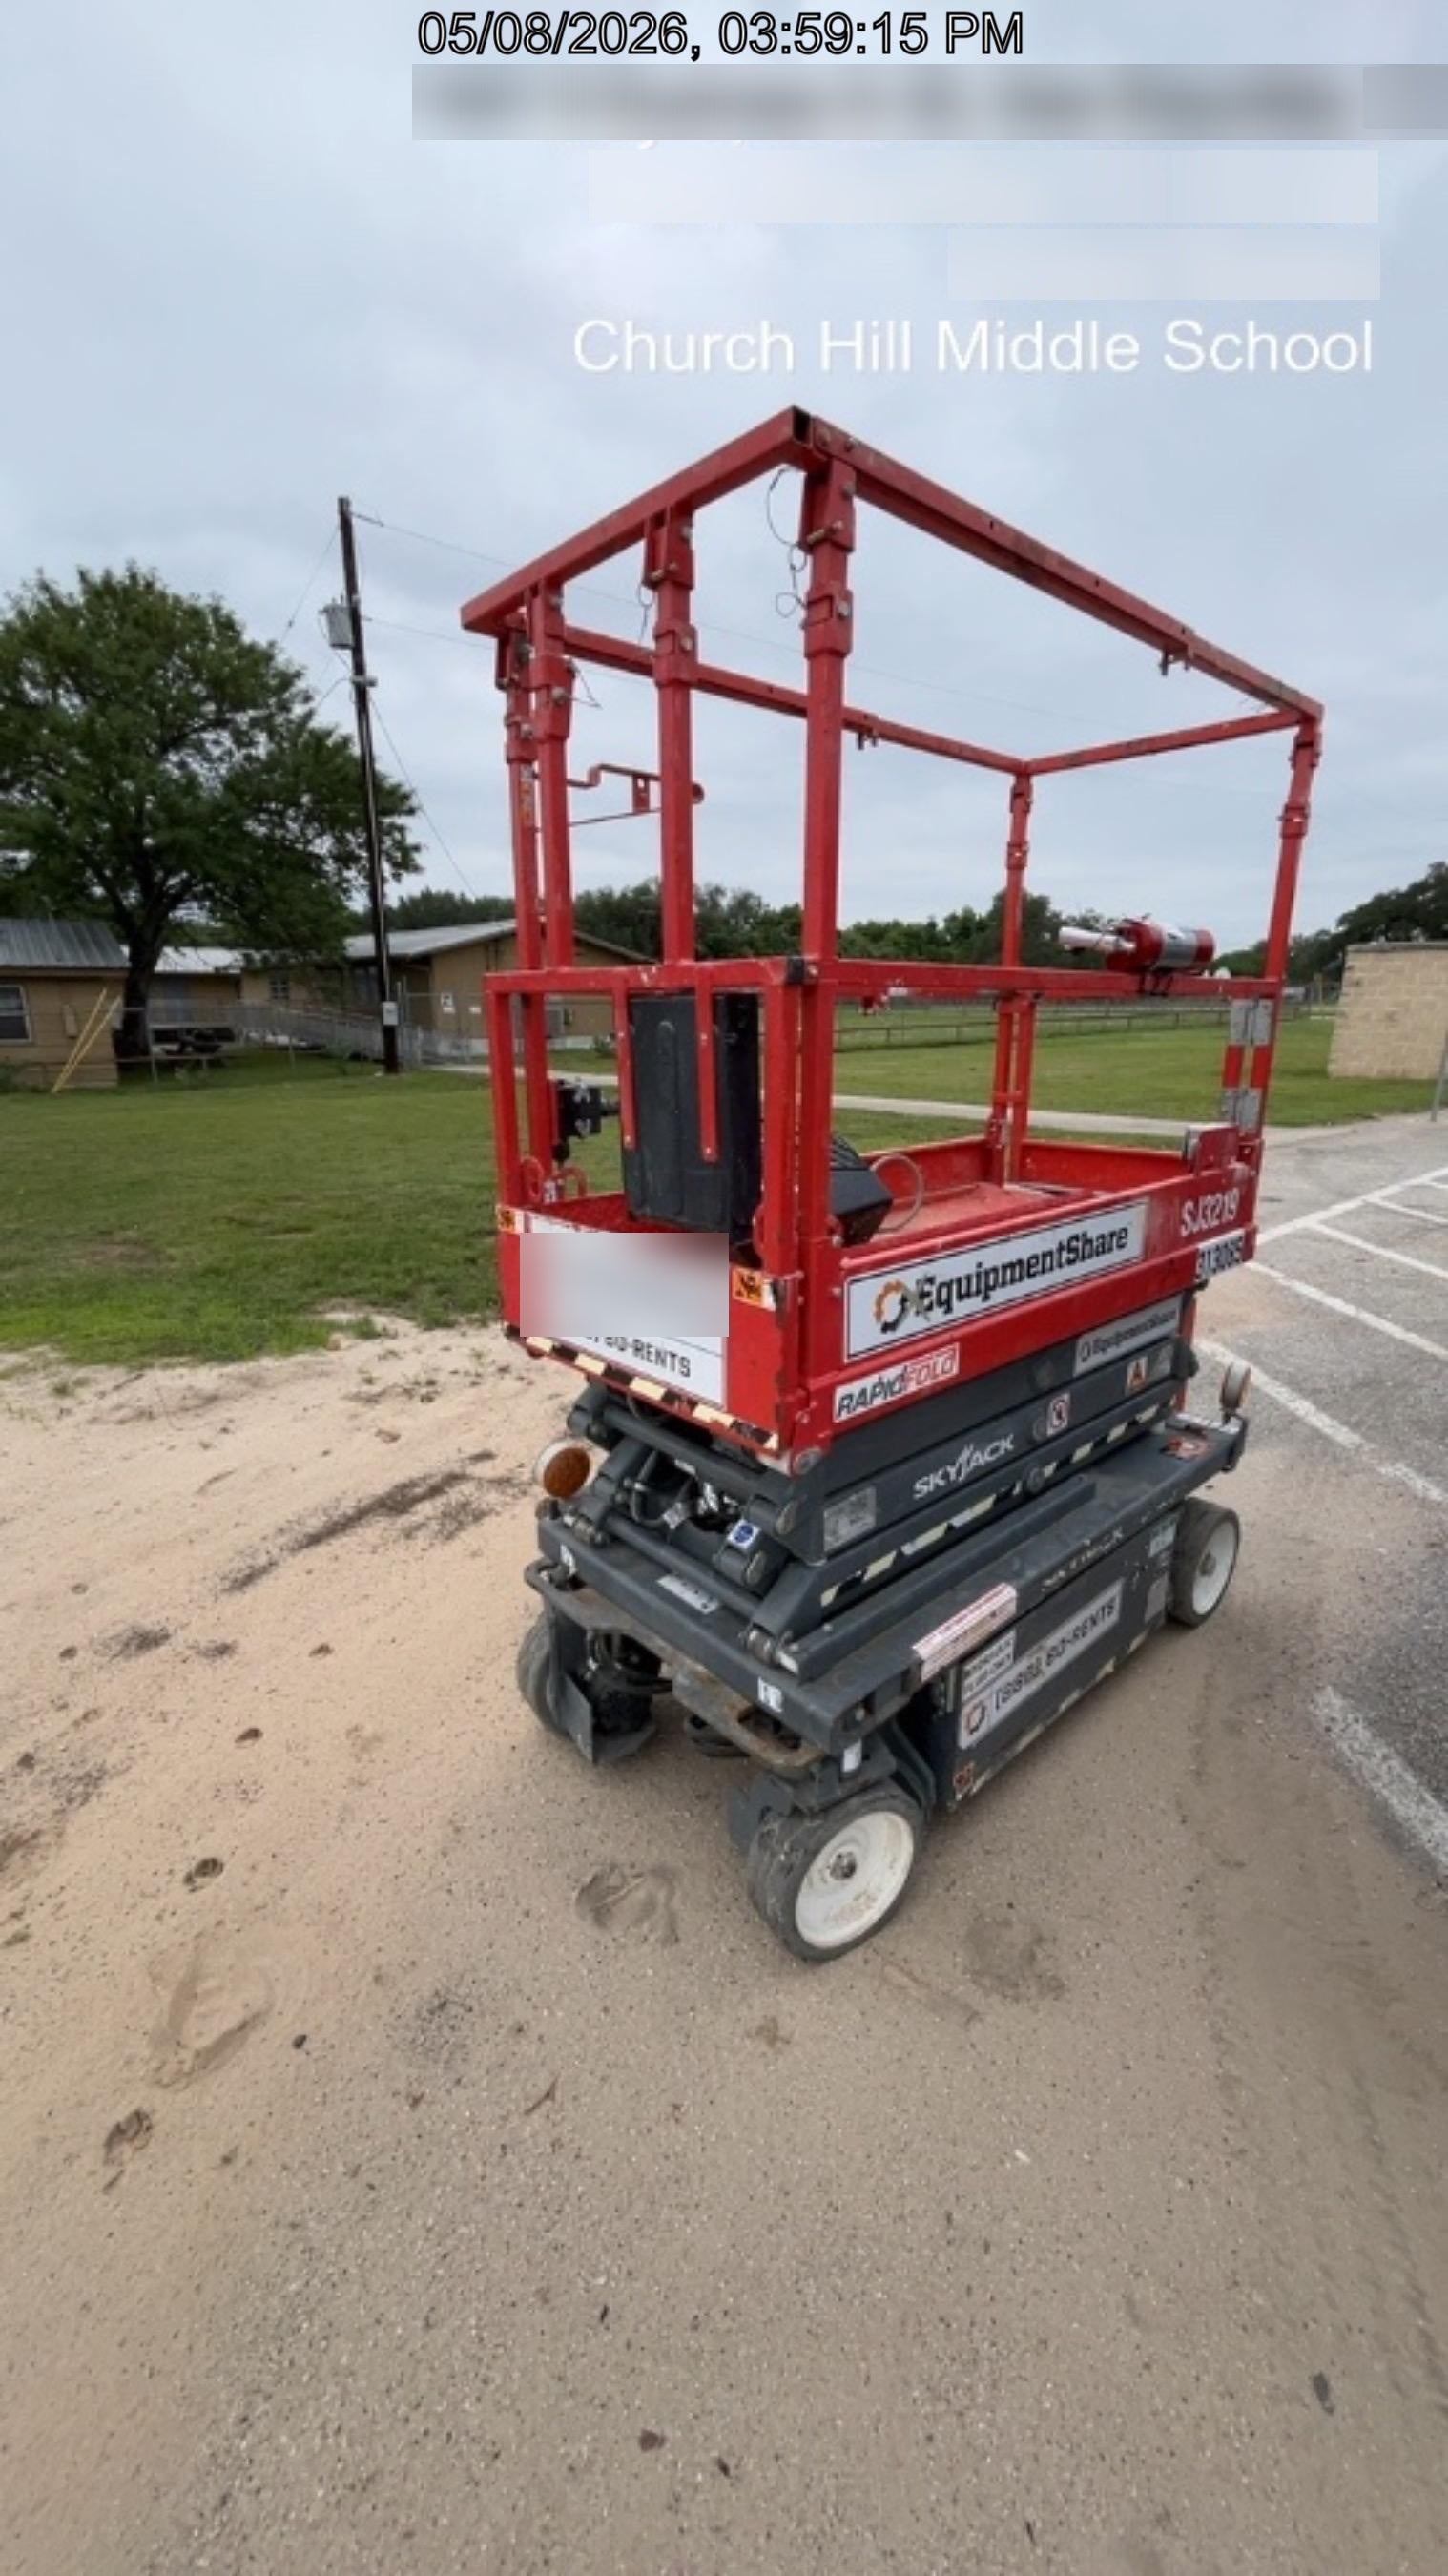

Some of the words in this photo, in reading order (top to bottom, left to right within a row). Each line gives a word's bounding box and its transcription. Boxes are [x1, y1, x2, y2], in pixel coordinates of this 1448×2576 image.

[1181, 1187, 1239, 1237] SJ3219
[915, 1226, 1129, 1315] EquipmentShare
[913, 1433, 1015, 1501] SKYJACK
